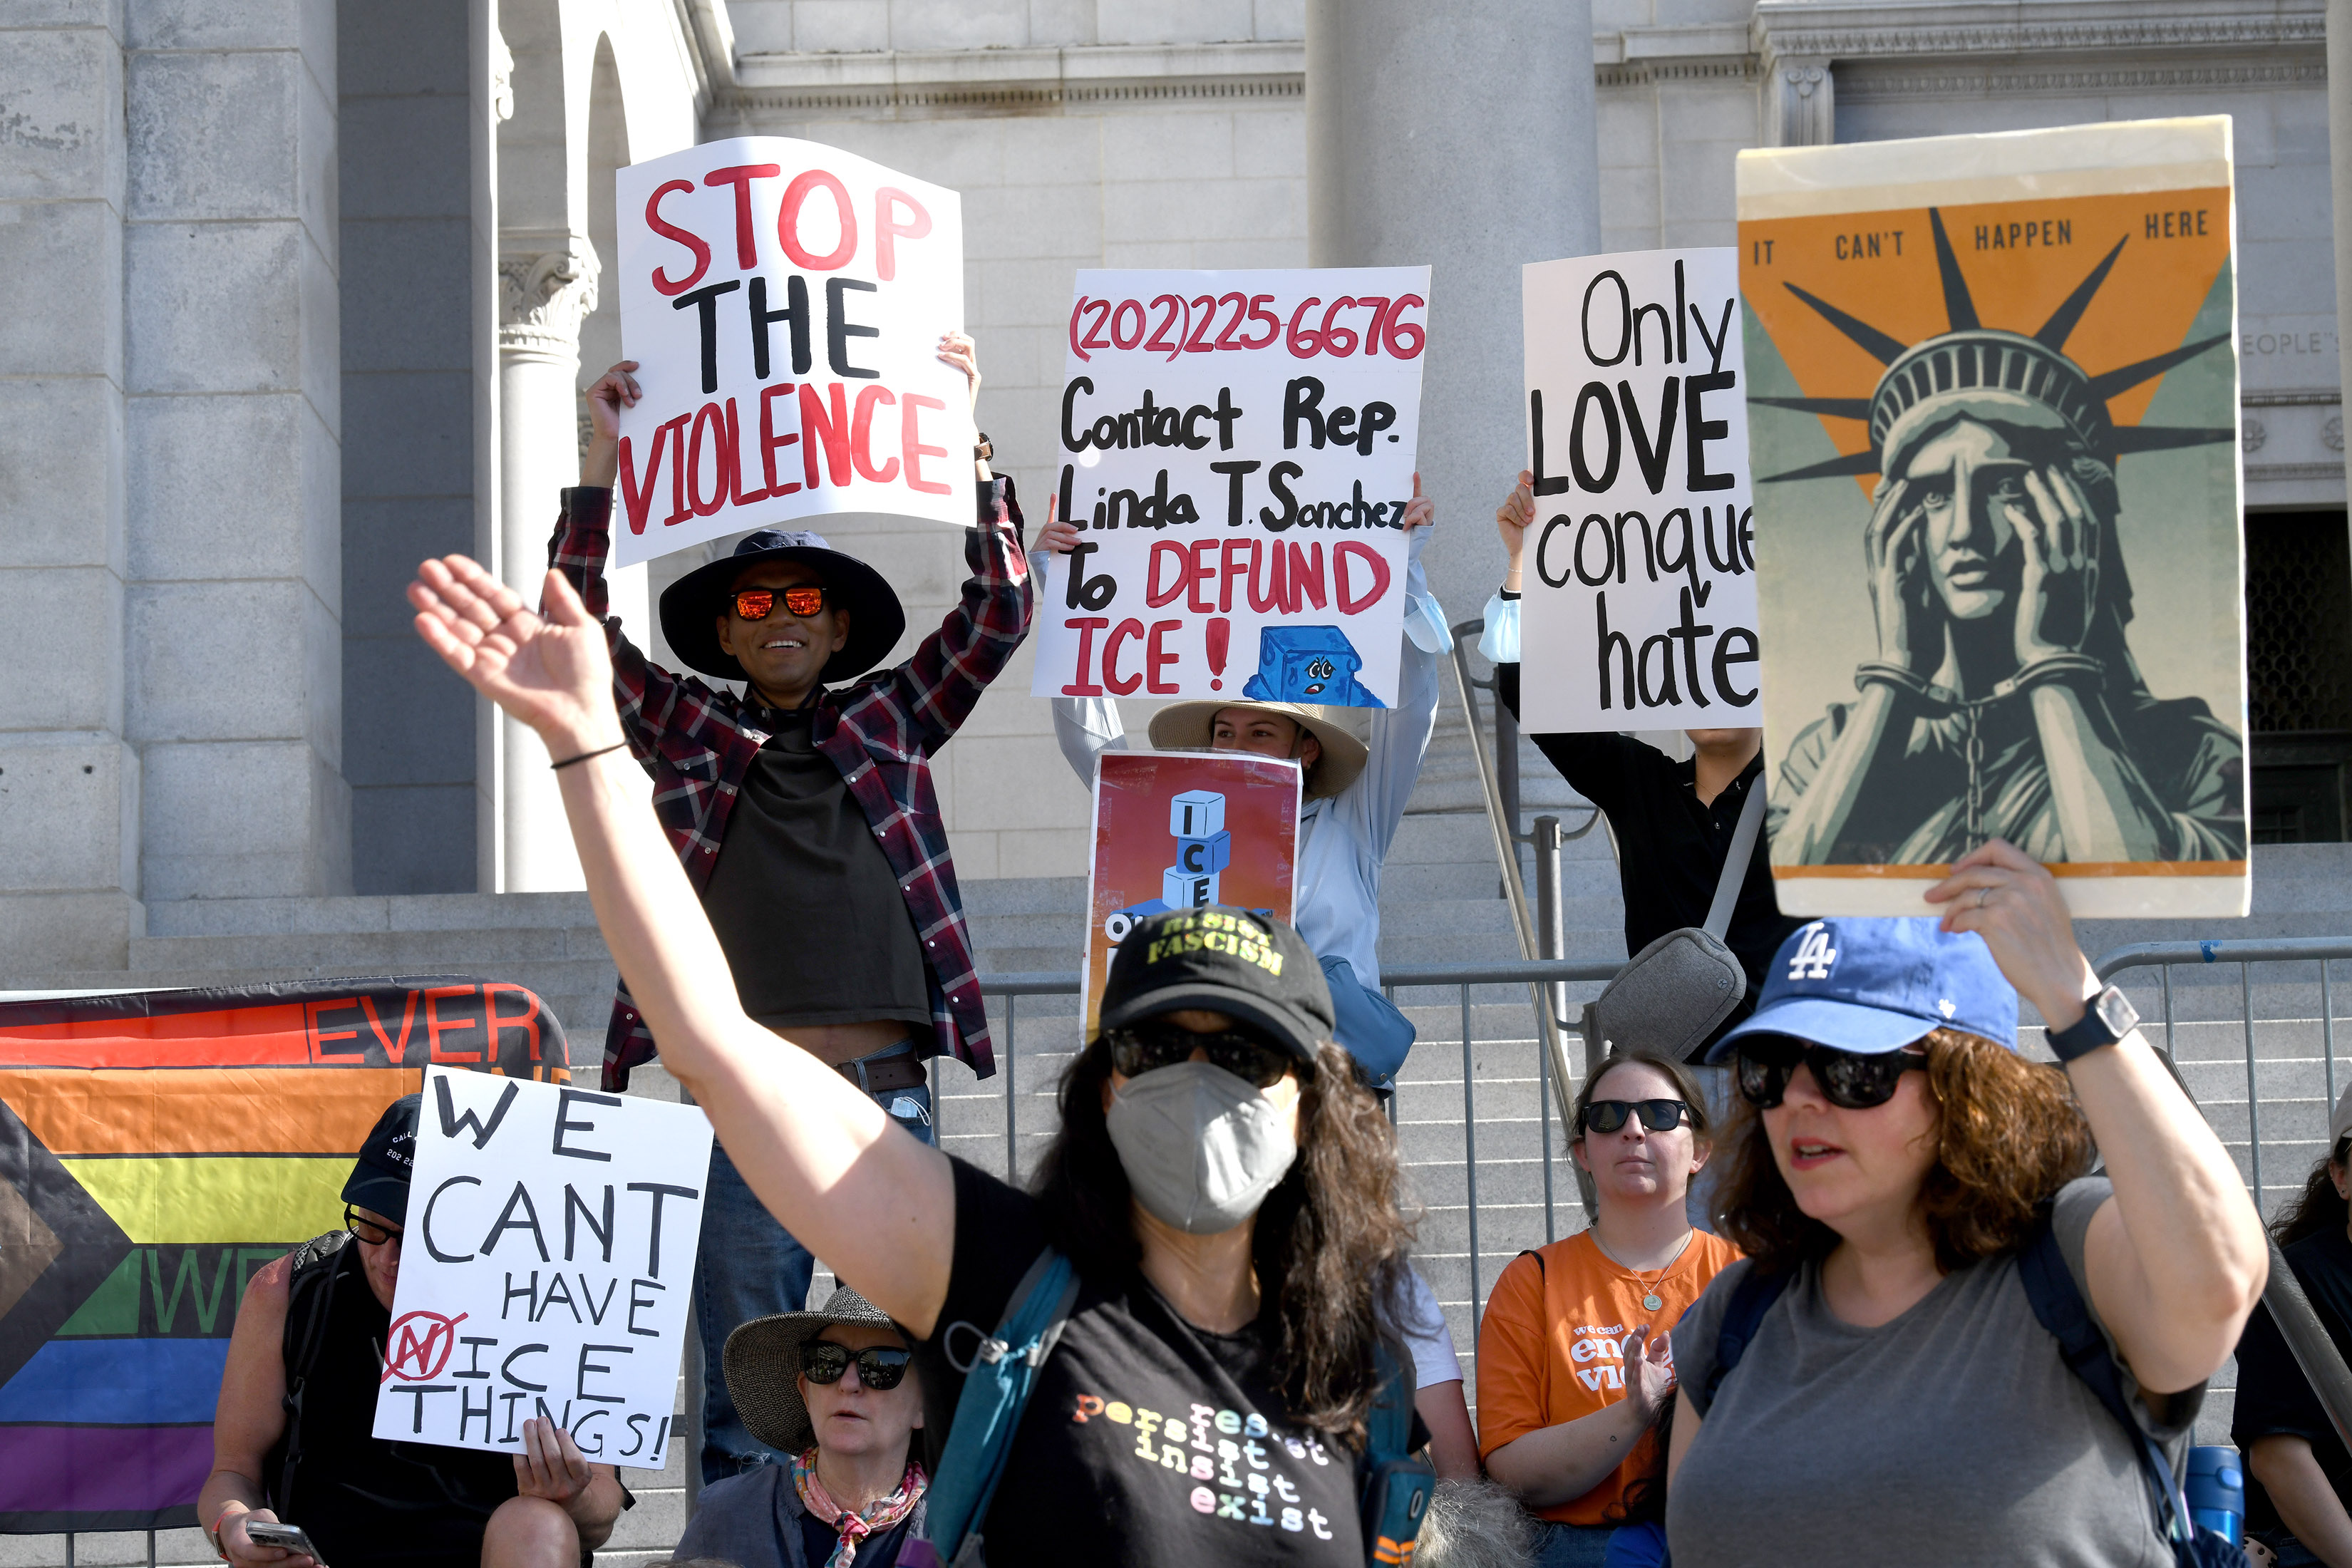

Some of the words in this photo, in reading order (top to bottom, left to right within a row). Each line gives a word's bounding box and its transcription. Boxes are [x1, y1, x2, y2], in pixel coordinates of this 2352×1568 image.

[645, 163, 932, 296] STOP
[1754, 240, 1775, 265] IT
[1836, 231, 1904, 260] CAN'T
[1976, 219, 2072, 251] HAPPEN
[2145, 210, 2208, 239] HERE
[672, 275, 880, 394] THE
[1581, 259, 1735, 374] Only
[1061, 376, 1243, 453] Contact
[1283, 376, 1400, 456] Rep.
[1530, 370, 1735, 496] LOVE
[618, 383, 952, 535] VIOLENCE
[1058, 464, 1200, 532] Linda
[1145, 538, 1391, 616] DEFUND
[1596, 586, 1759, 710] hate
[1147, 931, 1284, 976] FASCISM
[1788, 922, 1837, 980] LA
[387, 1148, 402, 1161] 202
[392, 1131, 413, 1143] CALL
[433, 1075, 621, 1162] WE
[423, 1175, 698, 1279] CANT
[501, 1270, 666, 1337] HAVE
[1573, 1324, 1596, 1336] we
[1596, 1323, 1624, 1335] can
[390, 1385, 669, 1461] THINGS!
[1190, 1403, 1329, 1466] resst
[1134, 1429, 1301, 1503] insist
[1190, 1485, 1333, 1540] exist
